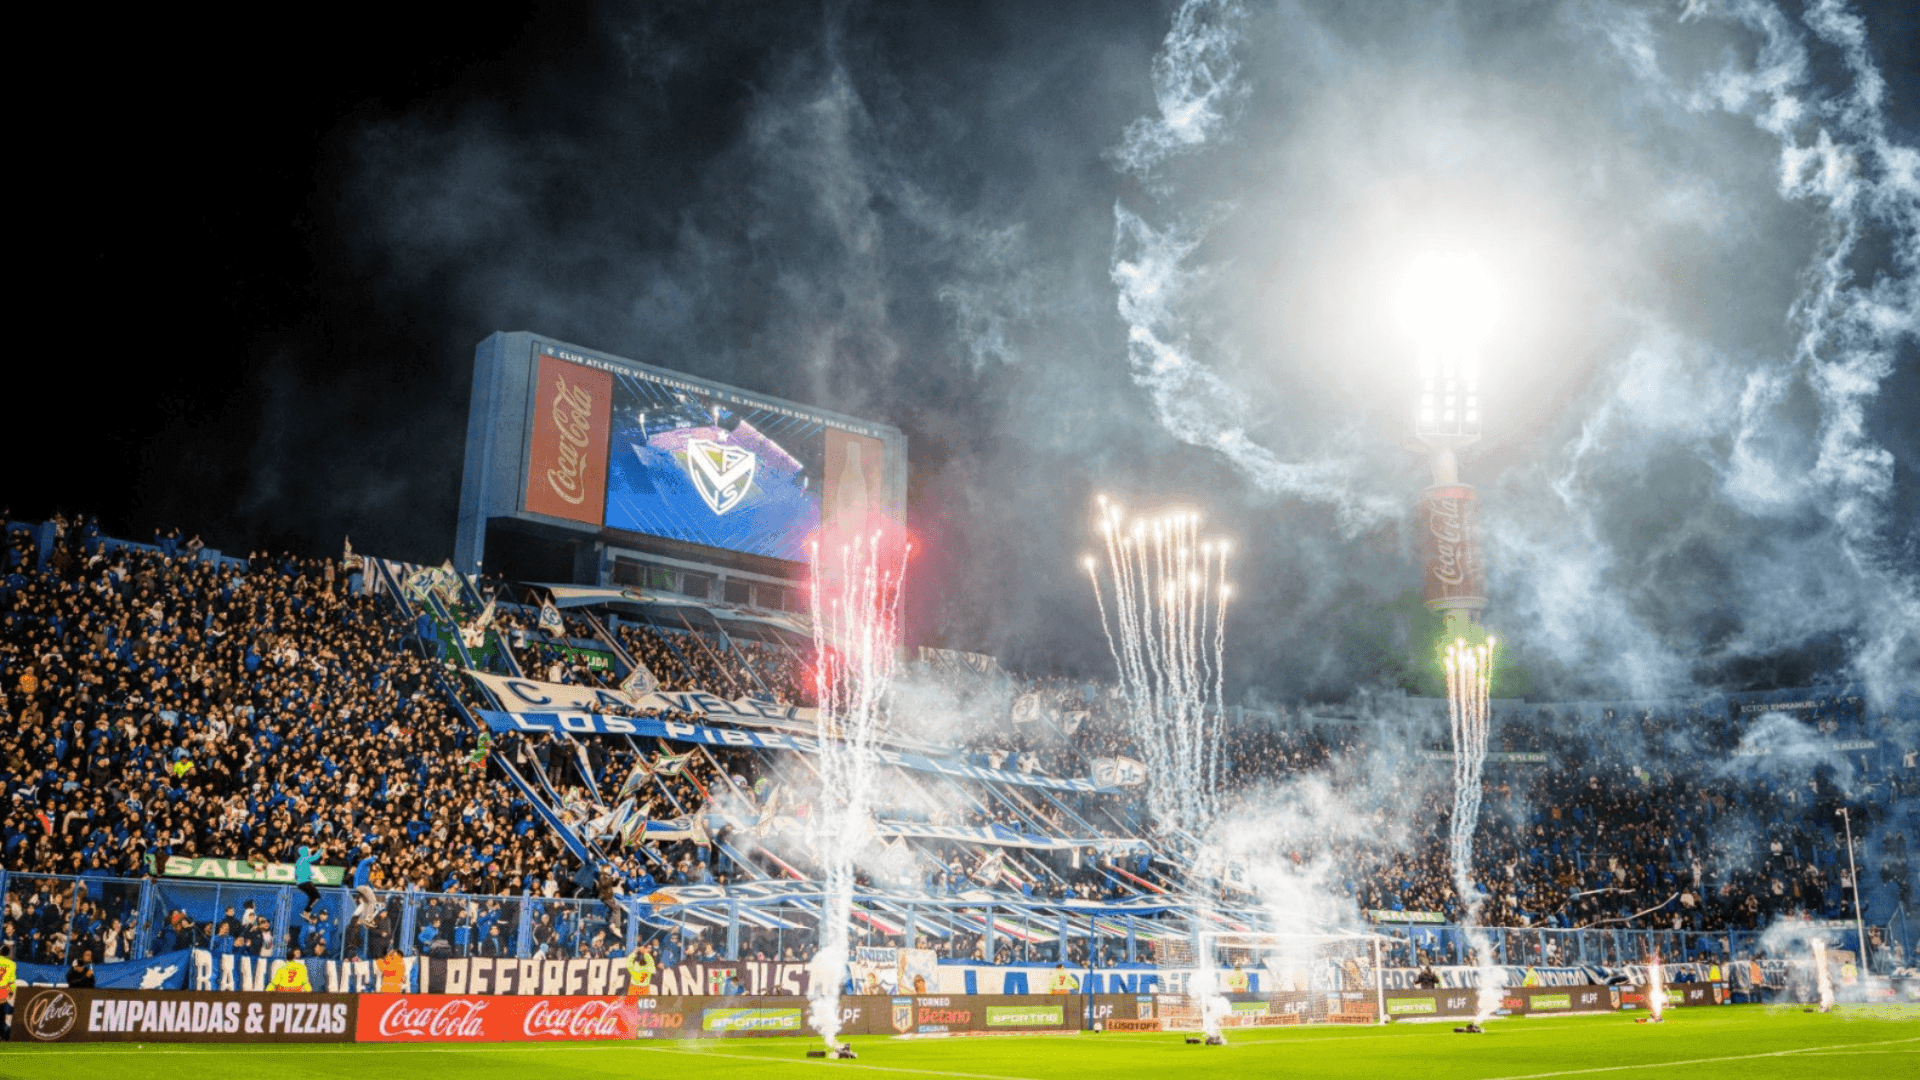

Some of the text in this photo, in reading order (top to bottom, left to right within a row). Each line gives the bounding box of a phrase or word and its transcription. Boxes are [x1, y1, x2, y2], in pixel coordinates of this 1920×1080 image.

[559, 352, 583, 363] CLUB
[663, 378, 711, 395] SARSFIELD
[511, 712, 637, 734] LOS
[88, 1000, 240, 1033] EMPANADAS
[244, 1003, 265, 1033] &
[269, 1003, 347, 1034] PIZZAS
[379, 999, 489, 1036] Coca-Cola
[523, 1000, 622, 1036] Coca-Cola
